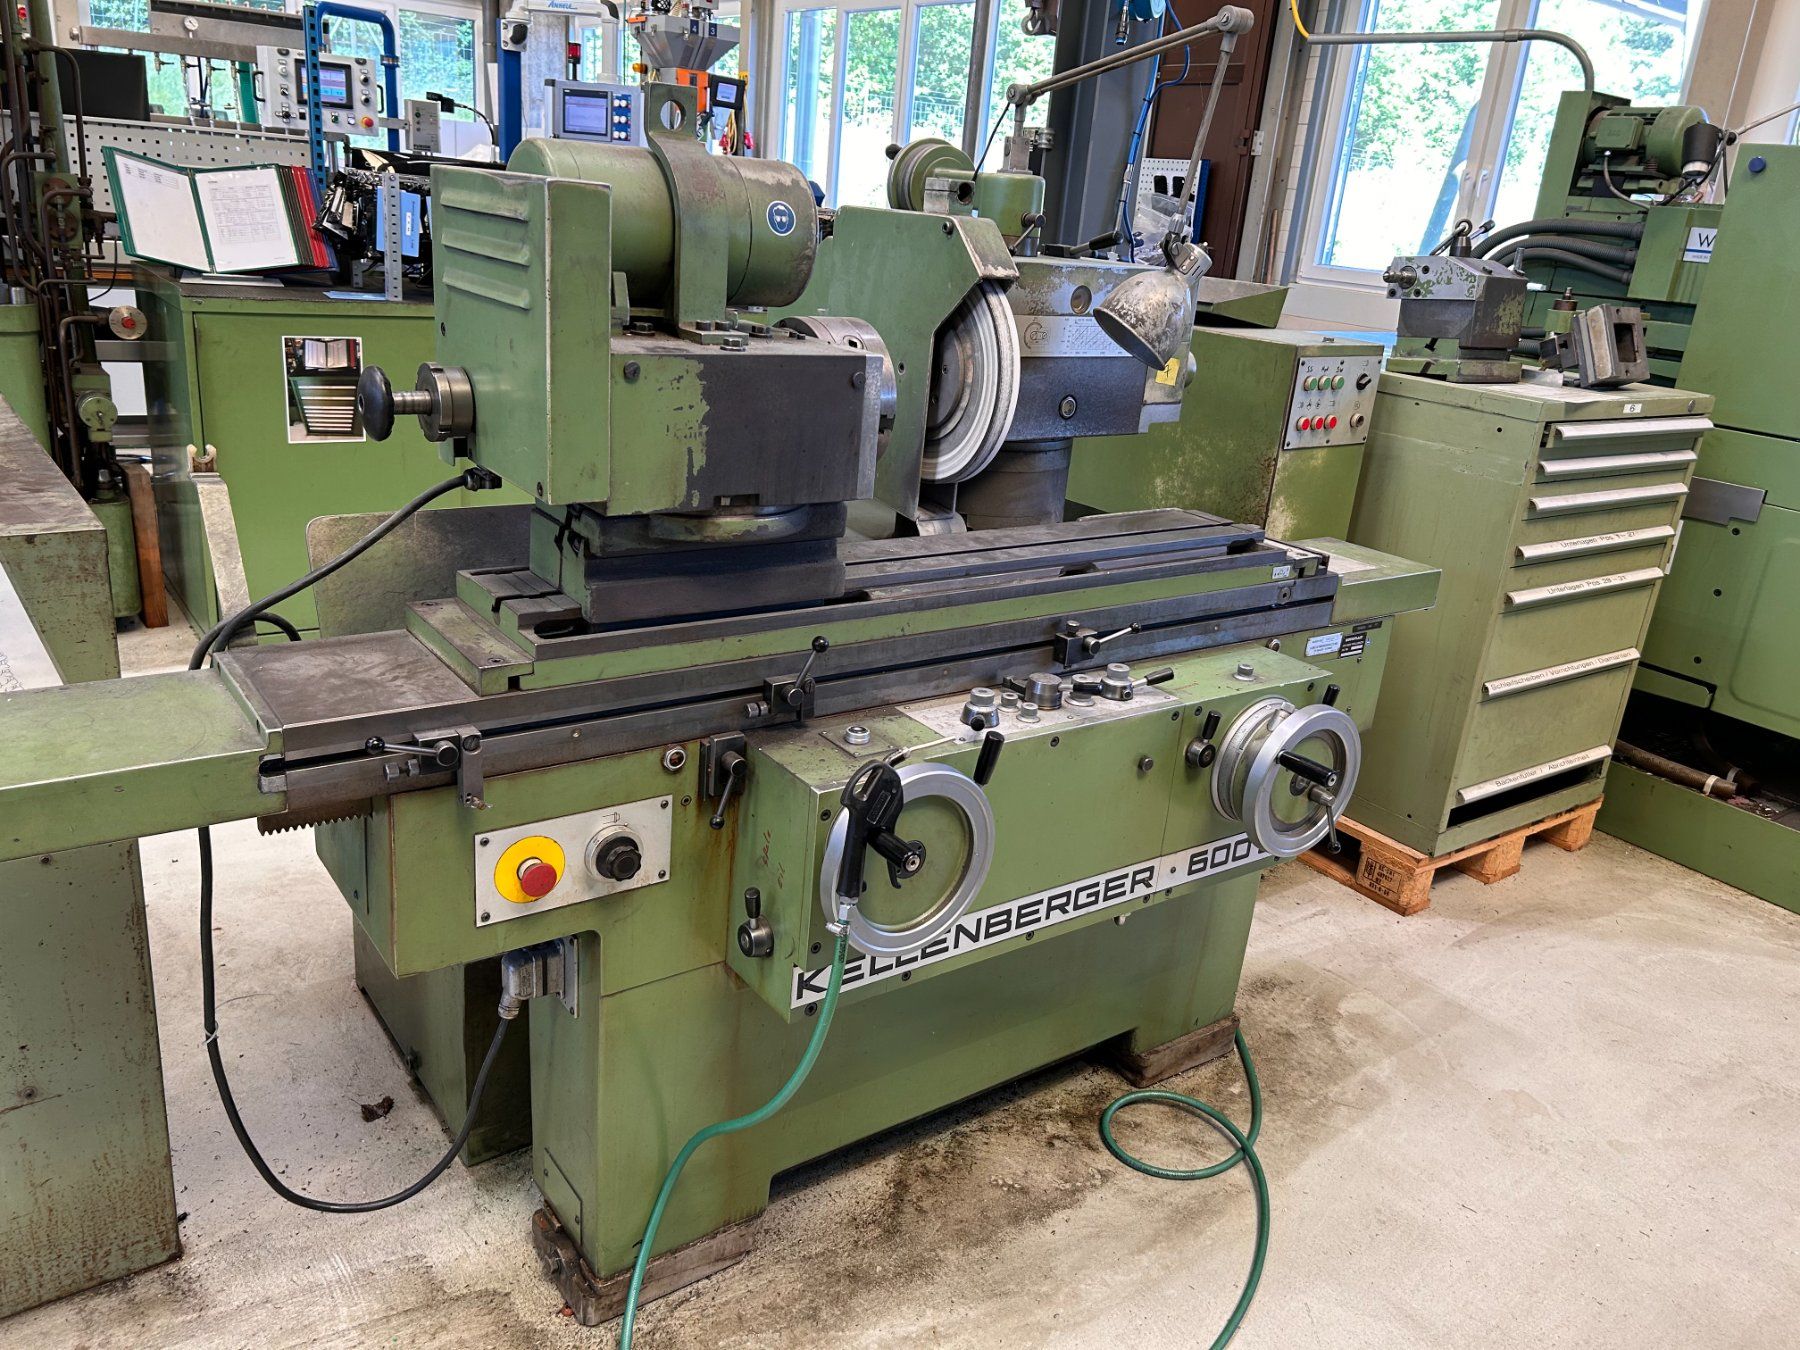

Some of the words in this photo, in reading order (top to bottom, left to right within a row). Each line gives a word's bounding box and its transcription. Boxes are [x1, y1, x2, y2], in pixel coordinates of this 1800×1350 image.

[1629, 404, 1635, 412] 6
[1560, 537, 1597, 548] Unterlagen
[1546, 583, 1585, 595] Unterlagen
[1490, 672, 1545, 691] Schleifscheiben
[1549, 660, 1594, 677] Vorrichtungen
[796, 865, 1155, 1000] KELLENBERGER
[1187, 837, 1252, 876] 600
